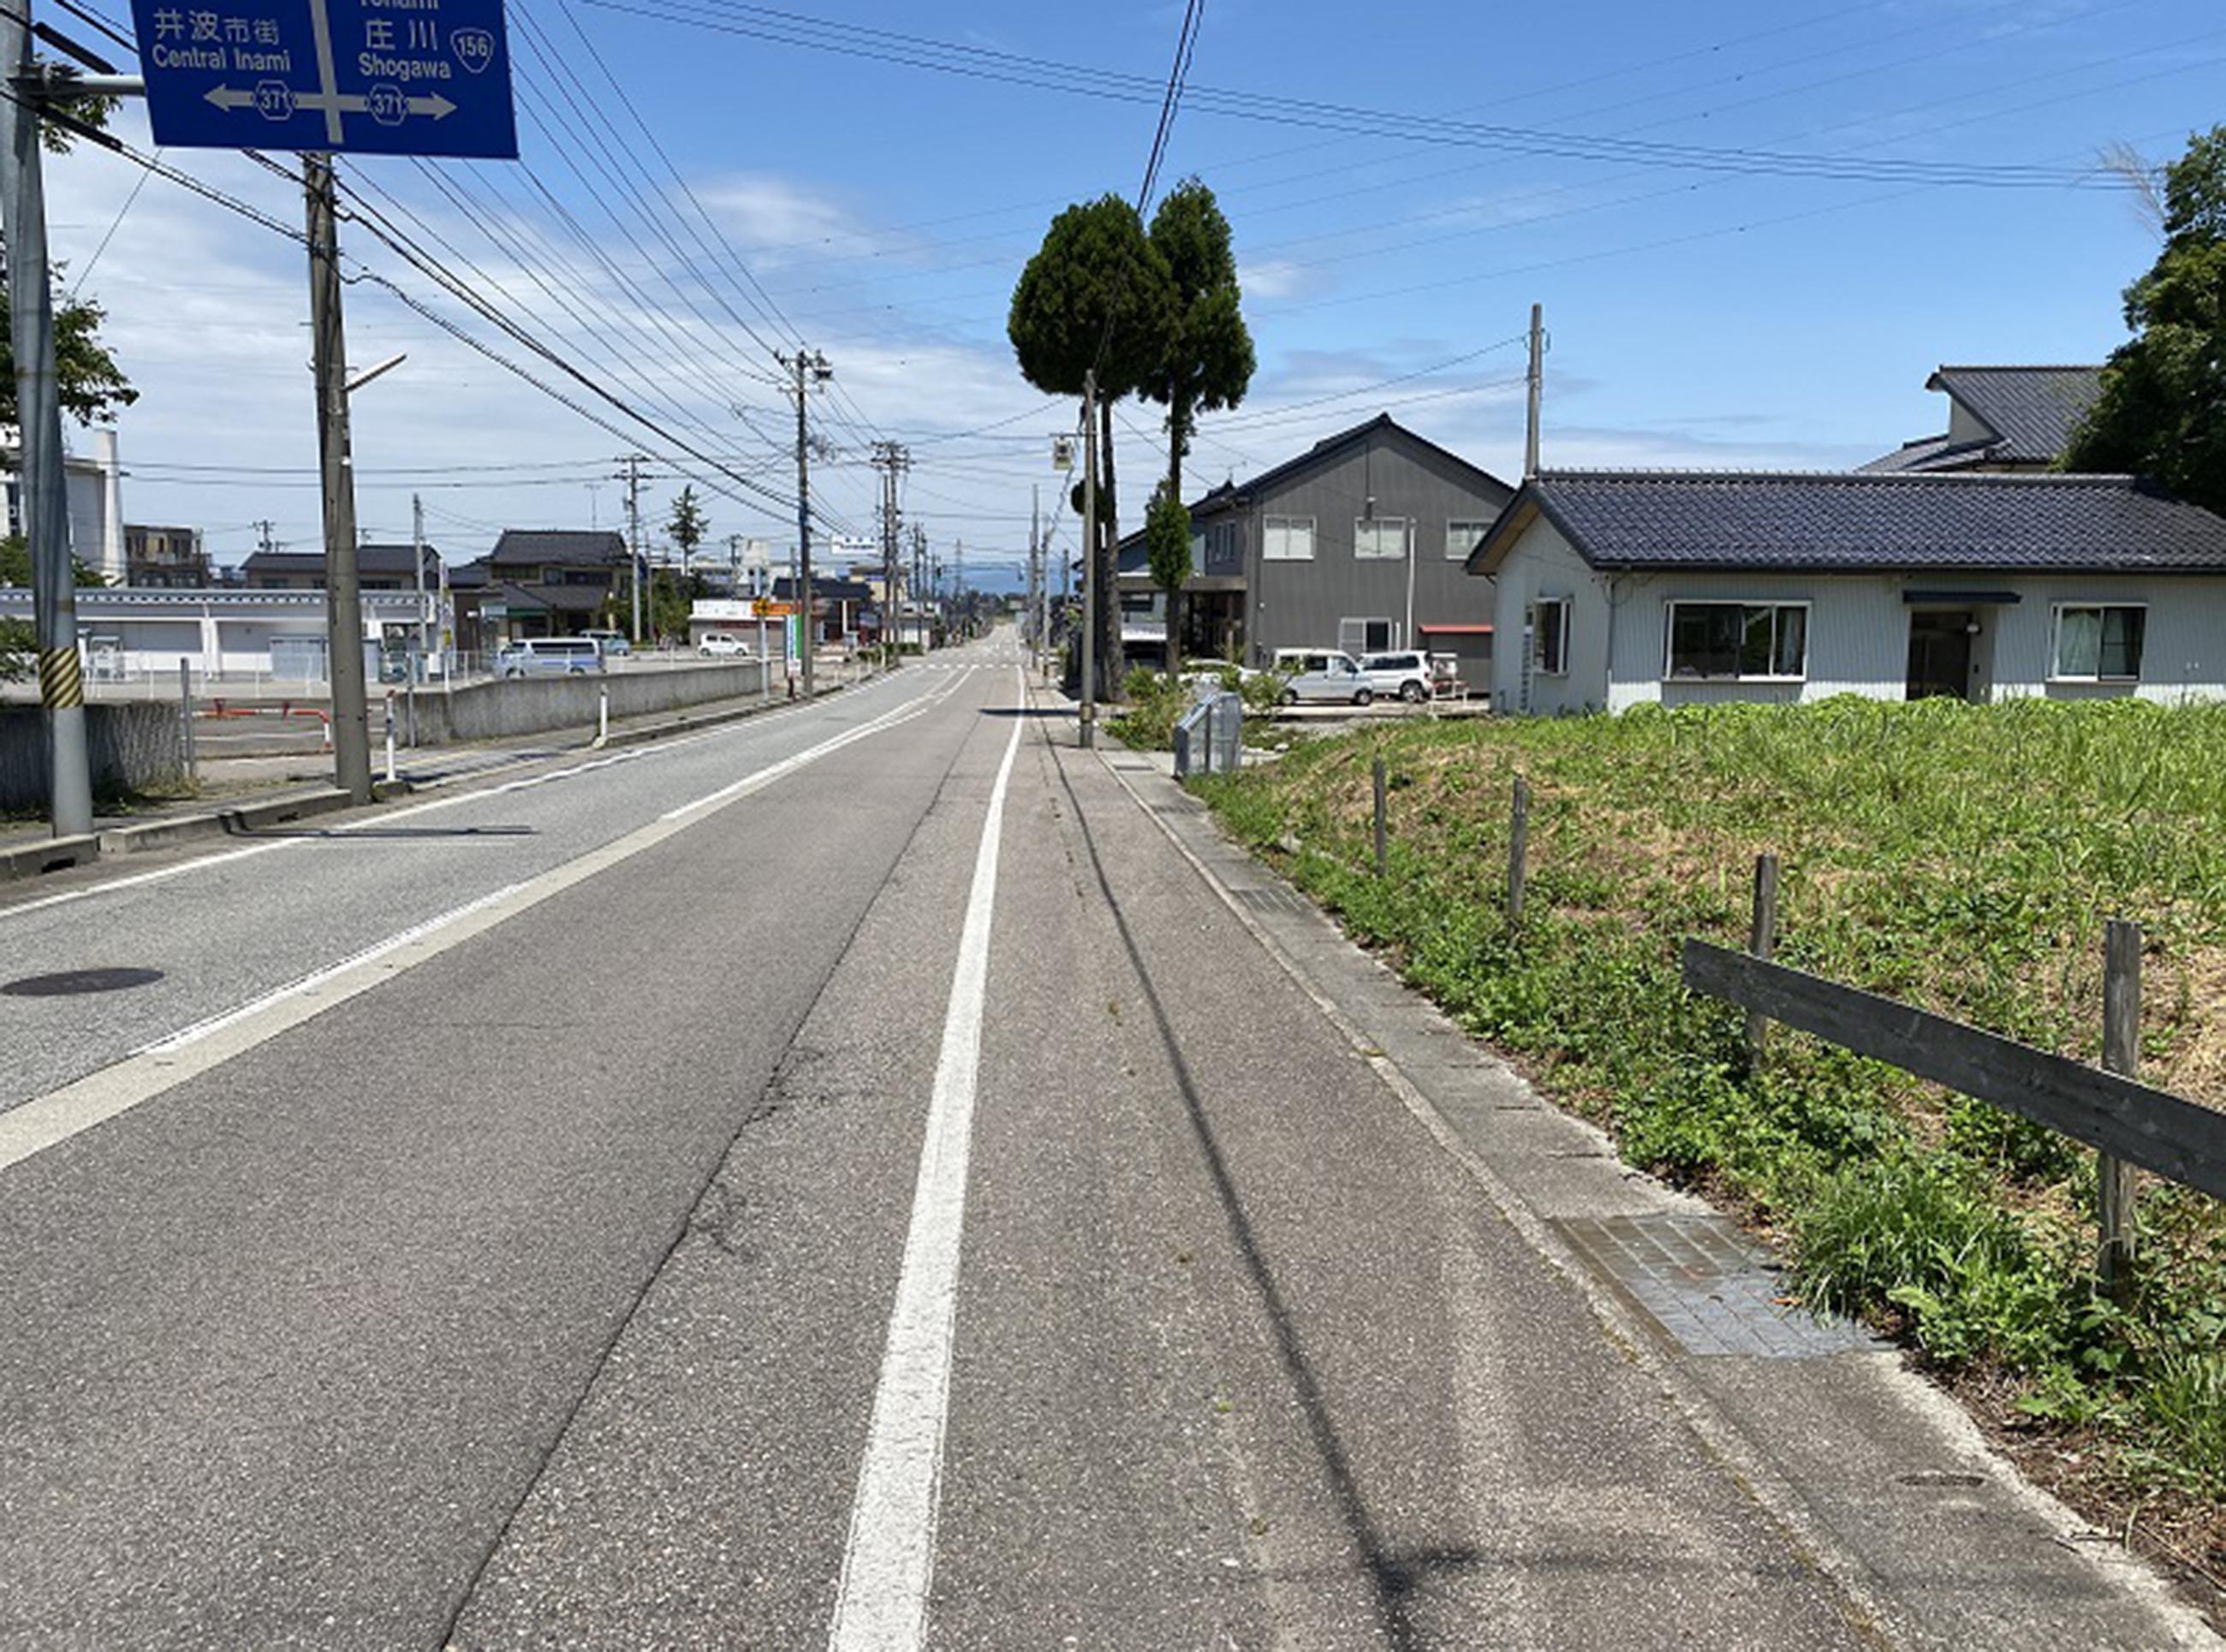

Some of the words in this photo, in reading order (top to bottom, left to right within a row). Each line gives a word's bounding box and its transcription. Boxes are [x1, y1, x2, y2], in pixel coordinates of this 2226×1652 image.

[153, 8, 279, 45] 井波市街
[152, 44, 227, 69] Central
[234, 48, 290, 71] Inami
[457, 35, 490, 57] 156
[358, 52, 451, 81] Shogawa
[260, 88, 289, 110] 371
[375, 93, 402, 115] 371
